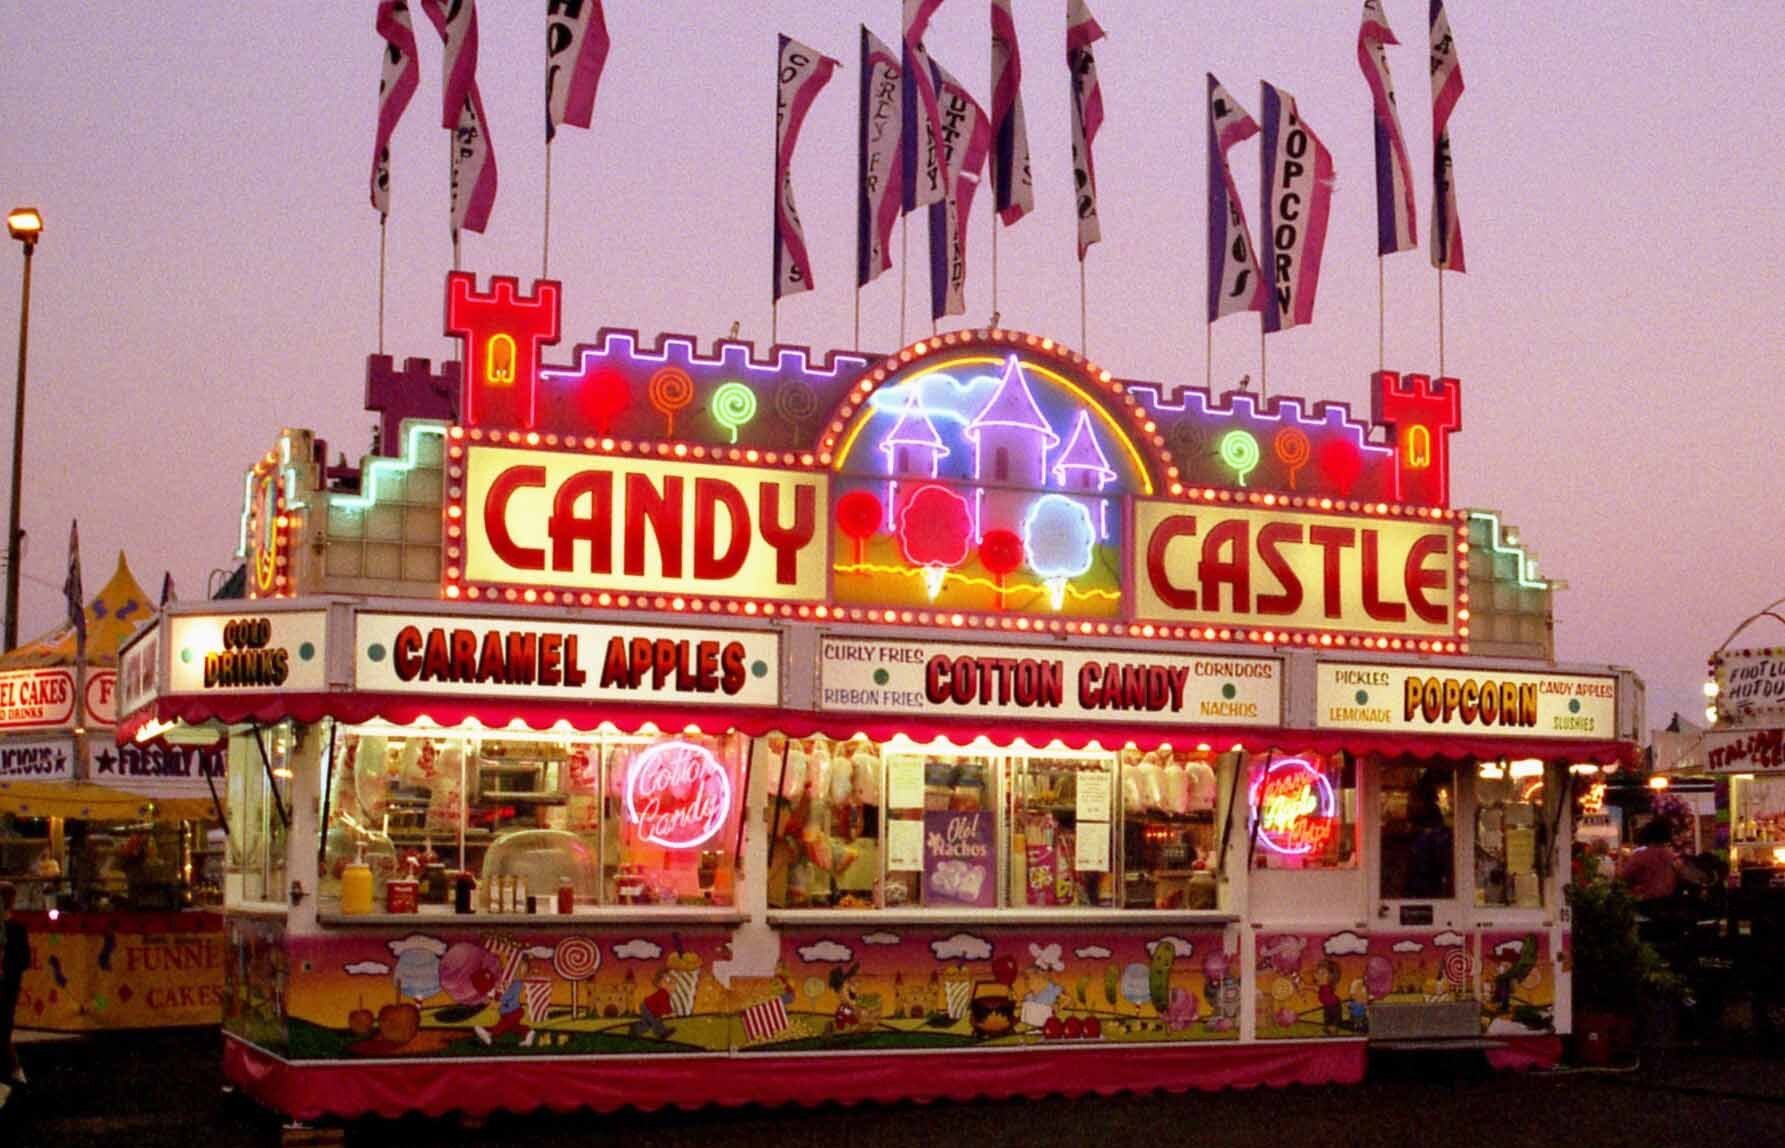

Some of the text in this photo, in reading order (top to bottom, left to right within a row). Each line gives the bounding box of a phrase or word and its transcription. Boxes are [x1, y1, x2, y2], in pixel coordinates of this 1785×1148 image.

[484, 465, 816, 585] CANDY
[1147, 515, 1449, 624] CASTLE
[223, 618, 271, 650] COLD
[394, 625, 746, 694] CARAMEL APPLES
[824, 643, 924, 664] CURLY FRIES
[204, 647, 289, 688] DRINKS
[1195, 661, 1273, 679] CORNDOGS
[1335, 670, 1390, 687] PICKLES
[20, 679, 67, 706] CAKES
[925, 654, 1190, 713] COTTON CANDY
[1539, 680, 1614, 699] CANDY APPLES
[824, 687, 924, 708] RIBBON FRIES
[1404, 676, 1537, 727] POPCORN
[8, 707, 43, 720] DRINKS
[1200, 702, 1257, 718] NACHOS
[1329, 707, 1391, 724] LEMONADE
[1553, 716, 1595, 732] SLUSHIES
[933, 834, 988, 858] Nachos
